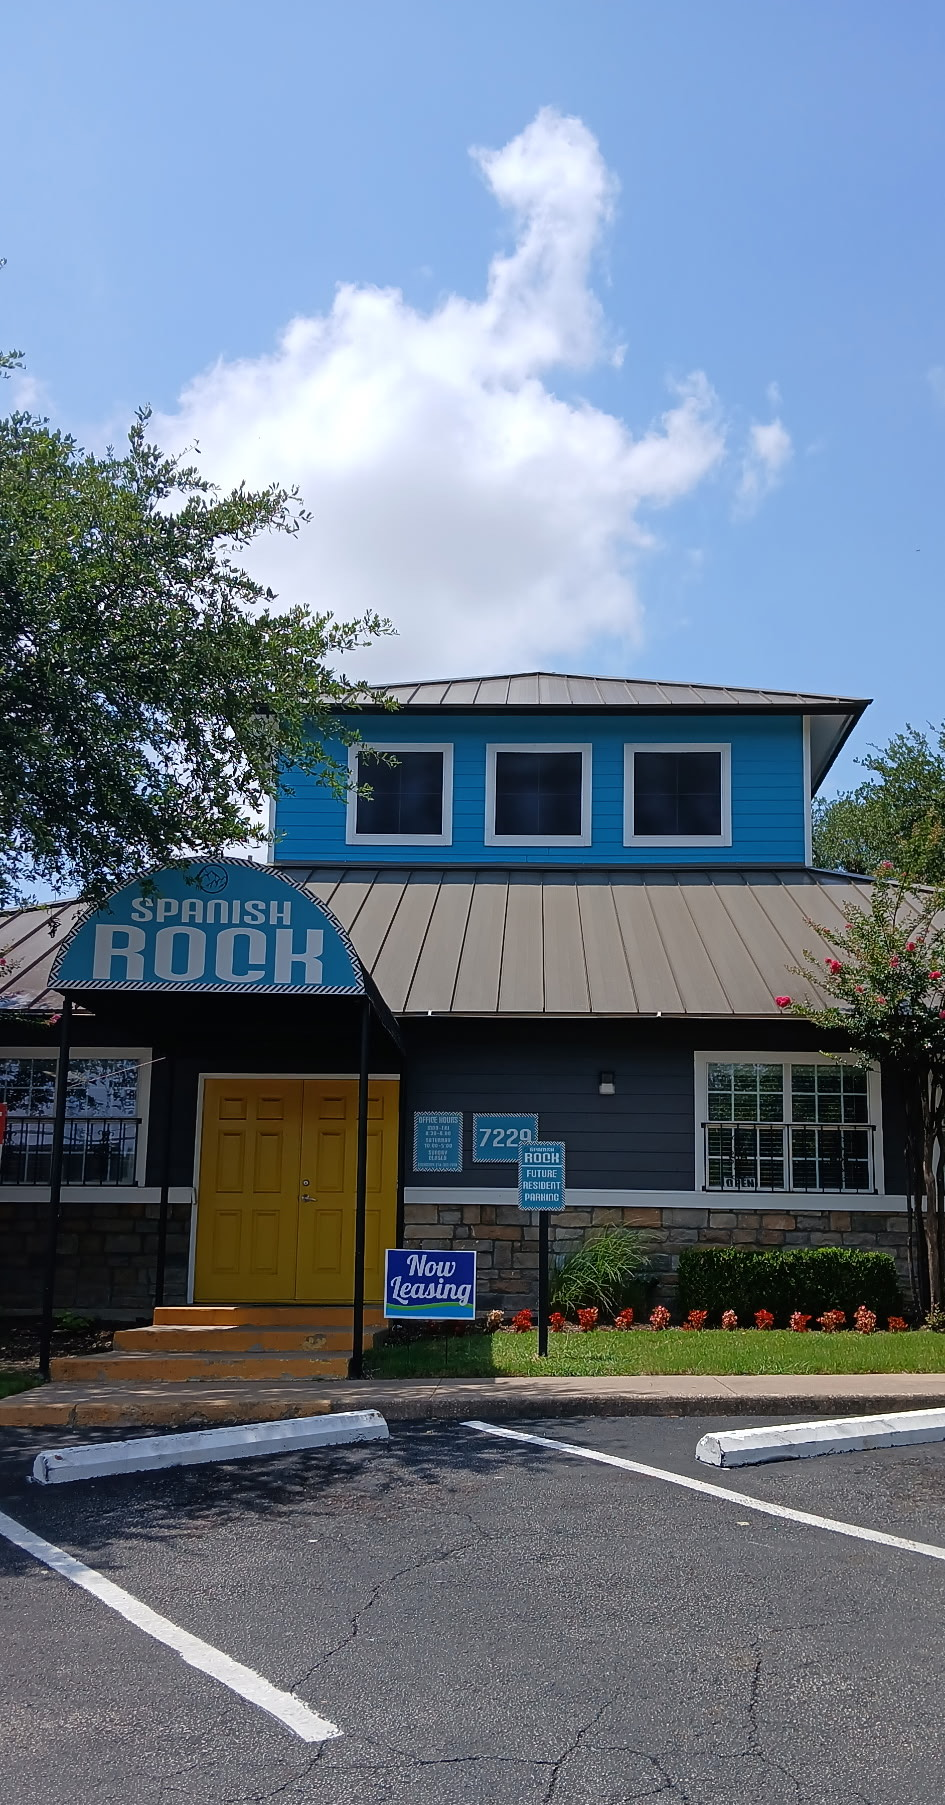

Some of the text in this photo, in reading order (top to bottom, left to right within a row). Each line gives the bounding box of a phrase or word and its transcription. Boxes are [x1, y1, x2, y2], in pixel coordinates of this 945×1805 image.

[130, 898, 291, 925] SPANISH
[92, 924, 324, 985] ROCK
[418, 1116, 459, 1124] OFFICE HOURS
[479, 1128, 532, 1147] 7229
[524, 1152, 560, 1163] ROCK
[526, 1169, 558, 1178] FUTURE
[522, 1181, 562, 1190] RESIDENT
[524, 1193, 560, 1202] PARKING
[406, 1254, 457, 1277] Now
[390, 1275, 472, 1306] Leasing
